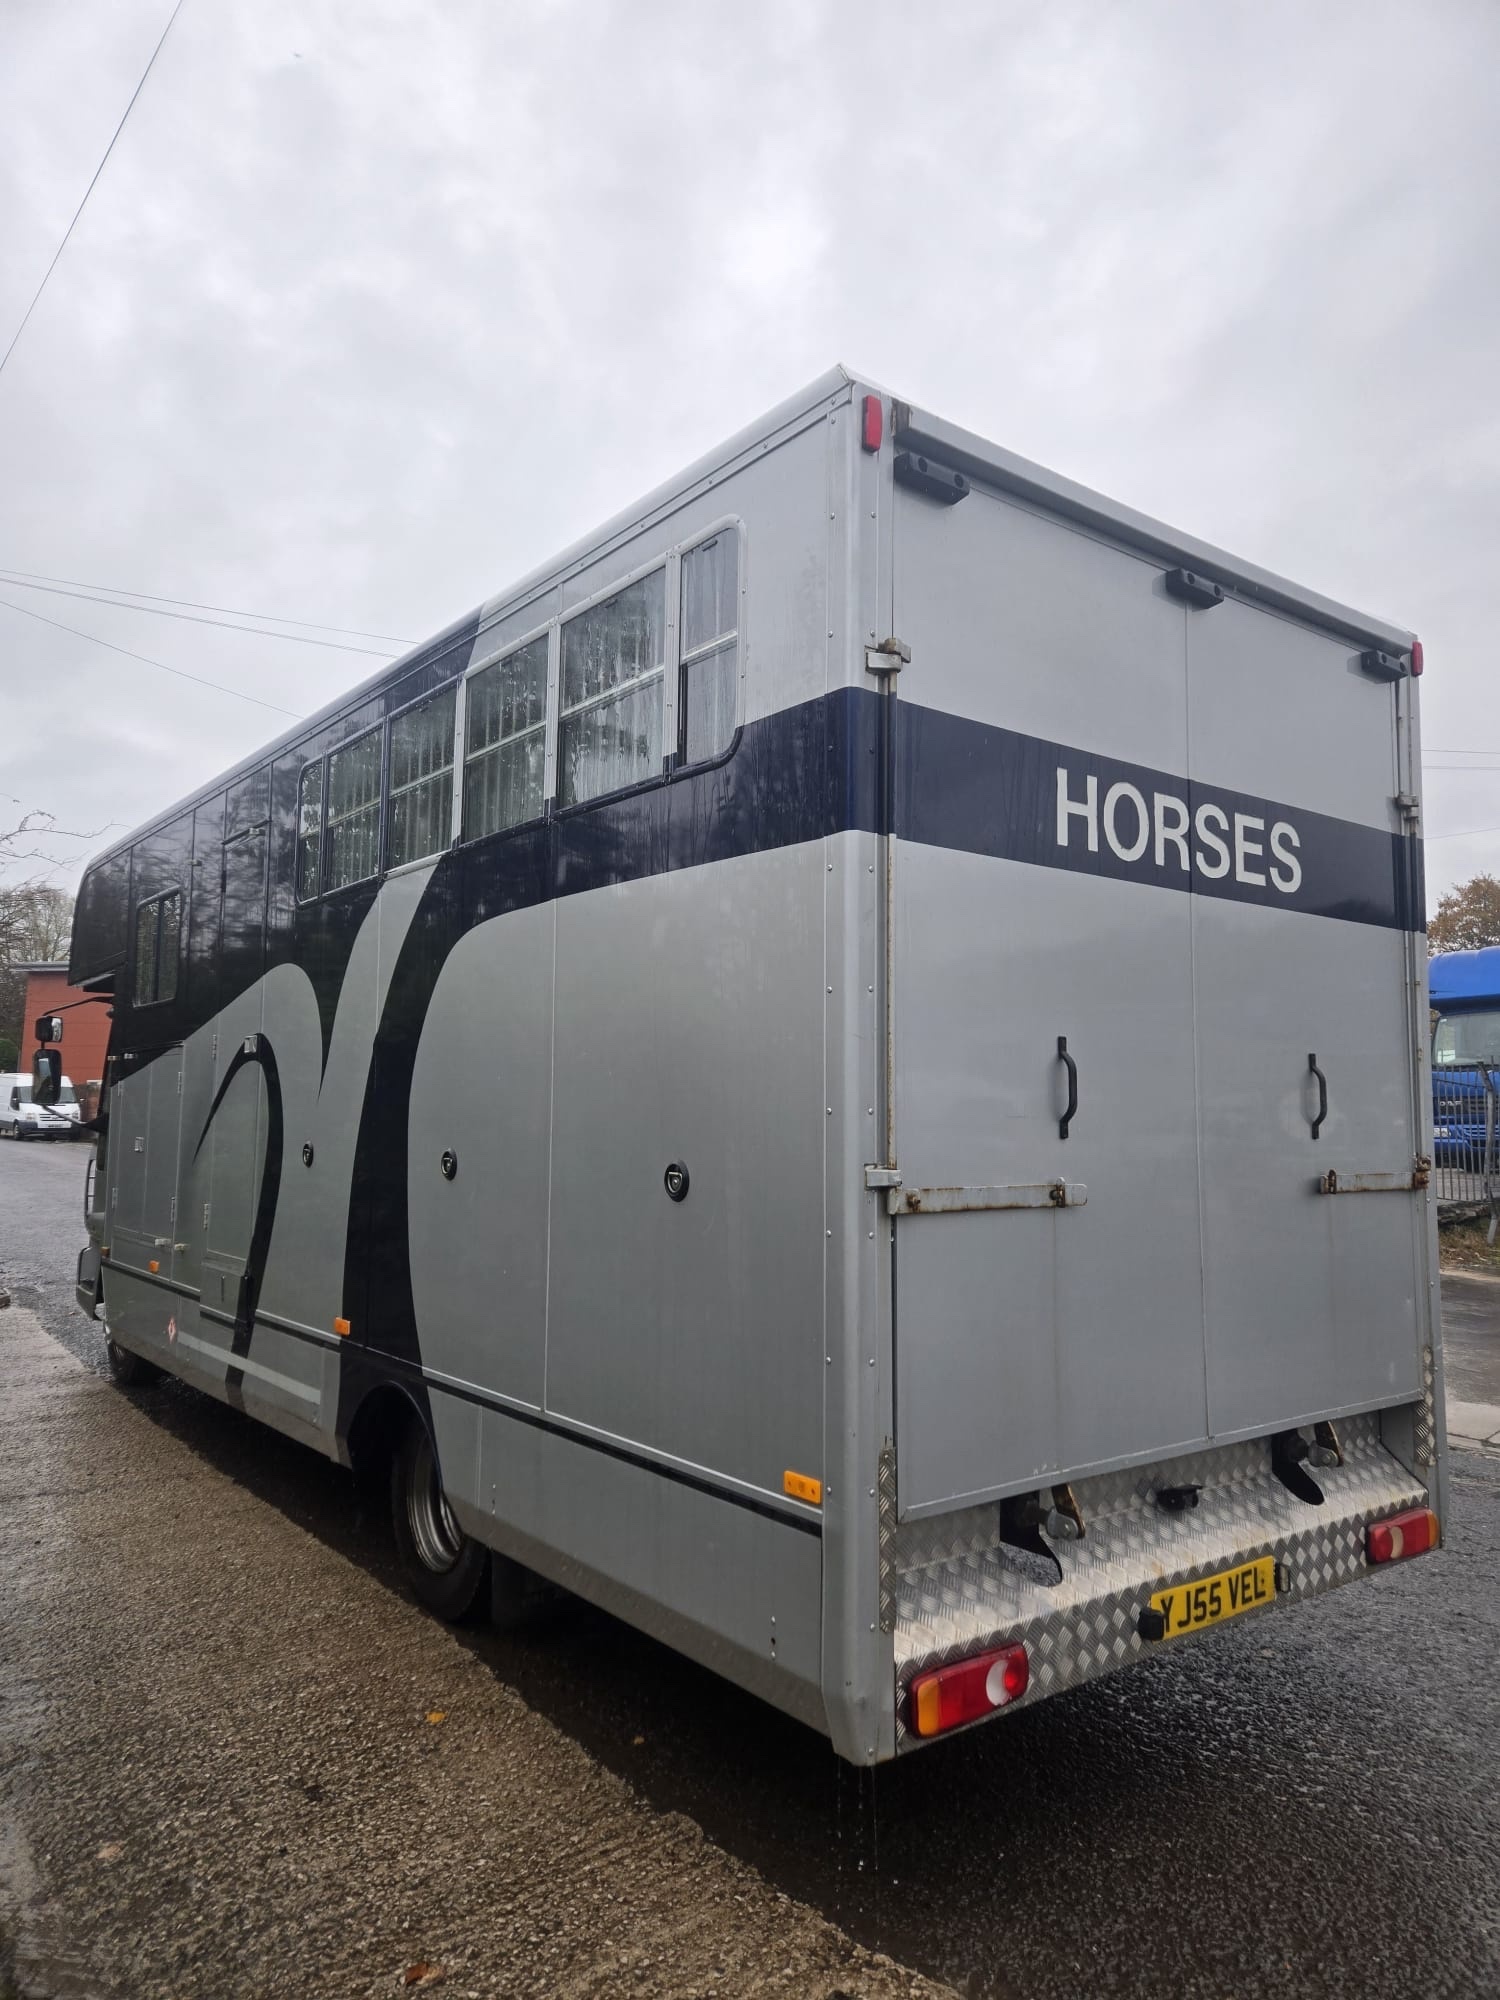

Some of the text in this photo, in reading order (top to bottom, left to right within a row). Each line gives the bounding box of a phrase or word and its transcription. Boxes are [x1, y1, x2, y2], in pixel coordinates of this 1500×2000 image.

[1056, 766, 1302, 893] HORSES
[1160, 1567, 1266, 1633] YJ55 VEL
